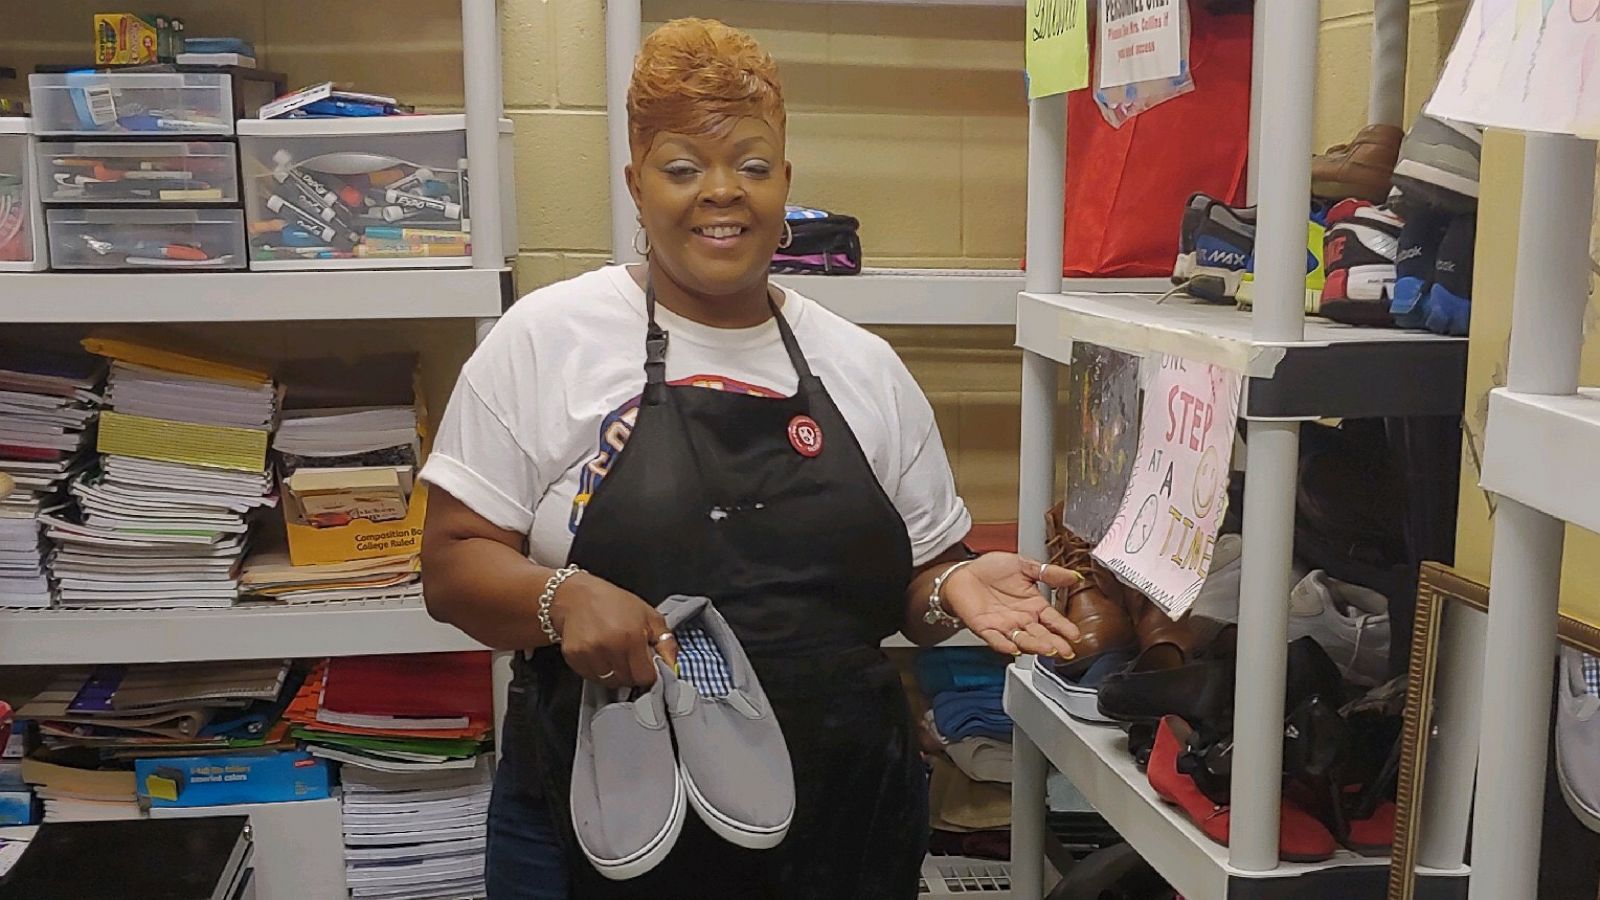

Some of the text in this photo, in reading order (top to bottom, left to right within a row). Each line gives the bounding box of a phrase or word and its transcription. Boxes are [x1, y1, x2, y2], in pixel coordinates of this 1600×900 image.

[1207, 249, 1246, 266] MAX
[1166, 384, 1213, 453] STEP
[1148, 448, 1163, 473] AT
[1159, 460, 1174, 499] A
[354, 529, 409, 542] Composition
[356, 537, 415, 551] College Ruled
[1160, 504, 1216, 579] TIME
